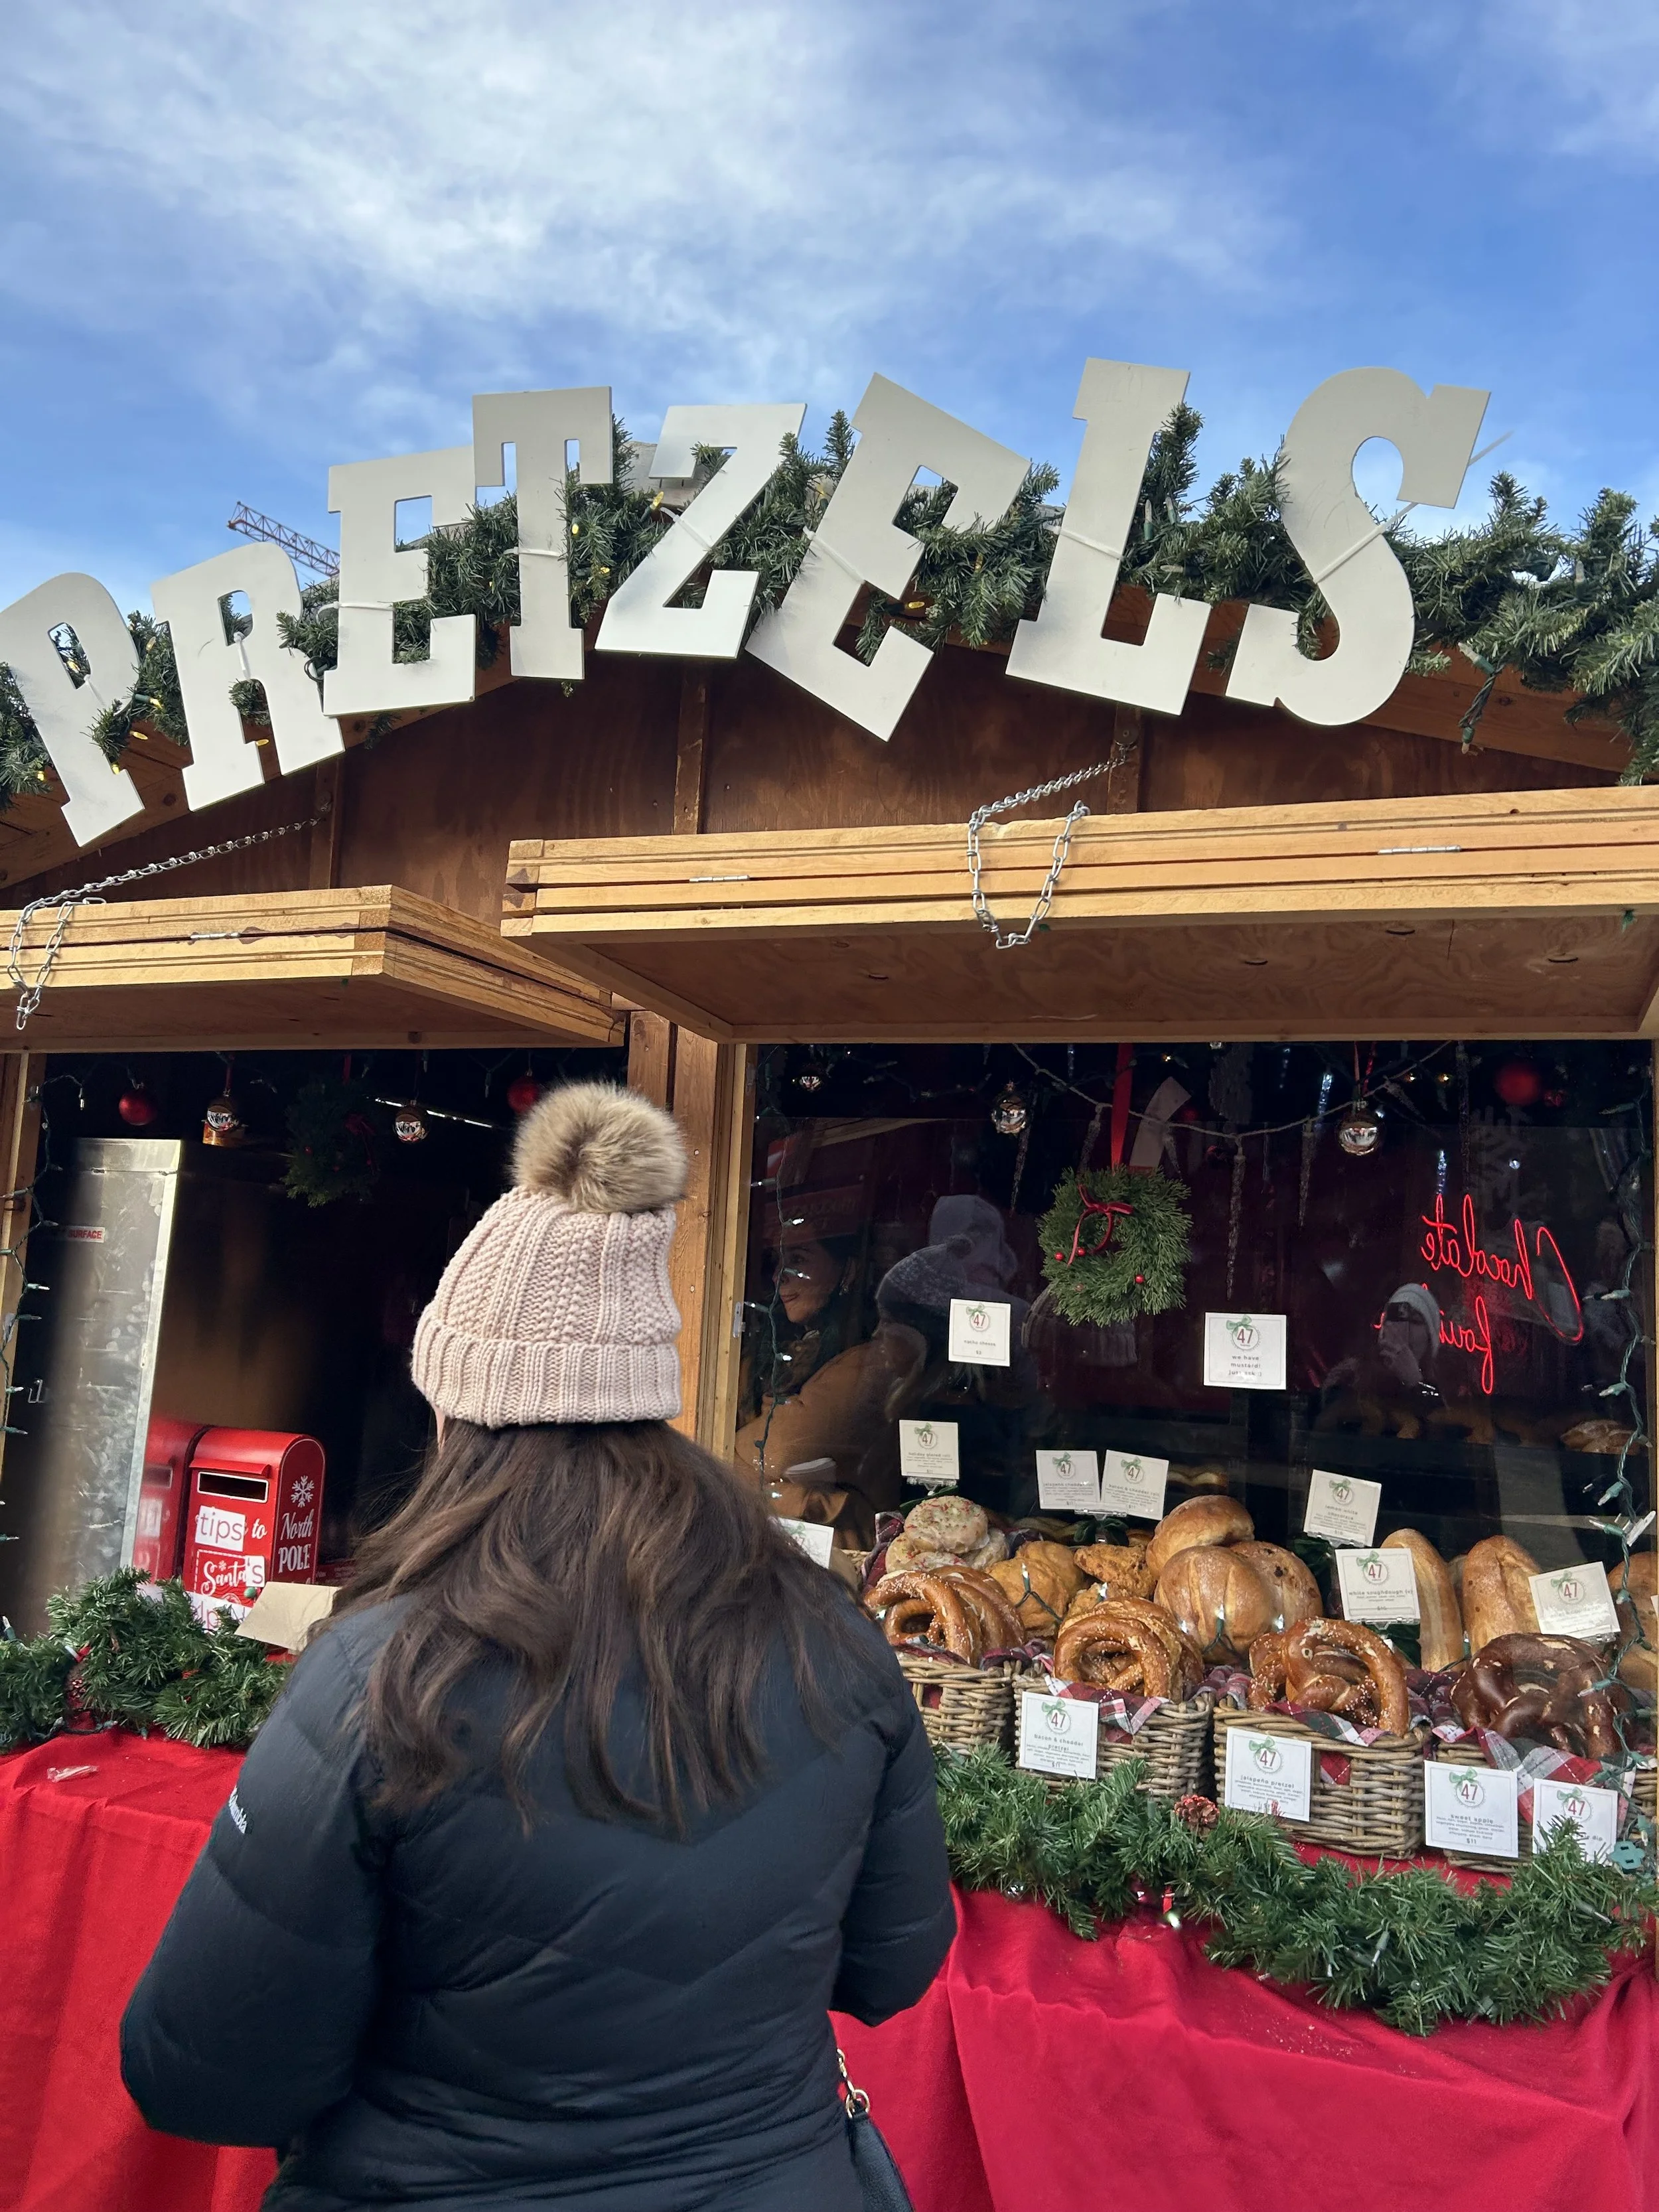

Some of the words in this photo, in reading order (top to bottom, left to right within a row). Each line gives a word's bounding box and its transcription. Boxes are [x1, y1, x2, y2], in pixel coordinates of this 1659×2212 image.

[0, 357, 1491, 847] PRETZELS
[68, 1229, 103, 1239] SURFACE
[973, 1313, 986, 1327] 47
[1236, 1328, 1254, 1344] 47
[922, 1433, 933, 1445] 47
[1060, 1463, 1071, 1474] 47
[1127, 1467, 1141, 1479] 47
[1336, 1487, 1350, 1501] 47
[200, 1511, 243, 1544] tips
[251, 1518, 268, 1540] to
[279, 1508, 315, 1541] North
[277, 1543, 312, 1574] POLE
[1368, 1564, 1382, 1578] 47
[1563, 1582, 1577, 1598] 47
[1050, 1712, 1066, 1728] 47
[1259, 1749, 1277, 1767] 47
[1461, 1783, 1479, 1801] 47
[1567, 1799, 1585, 1816] 47
